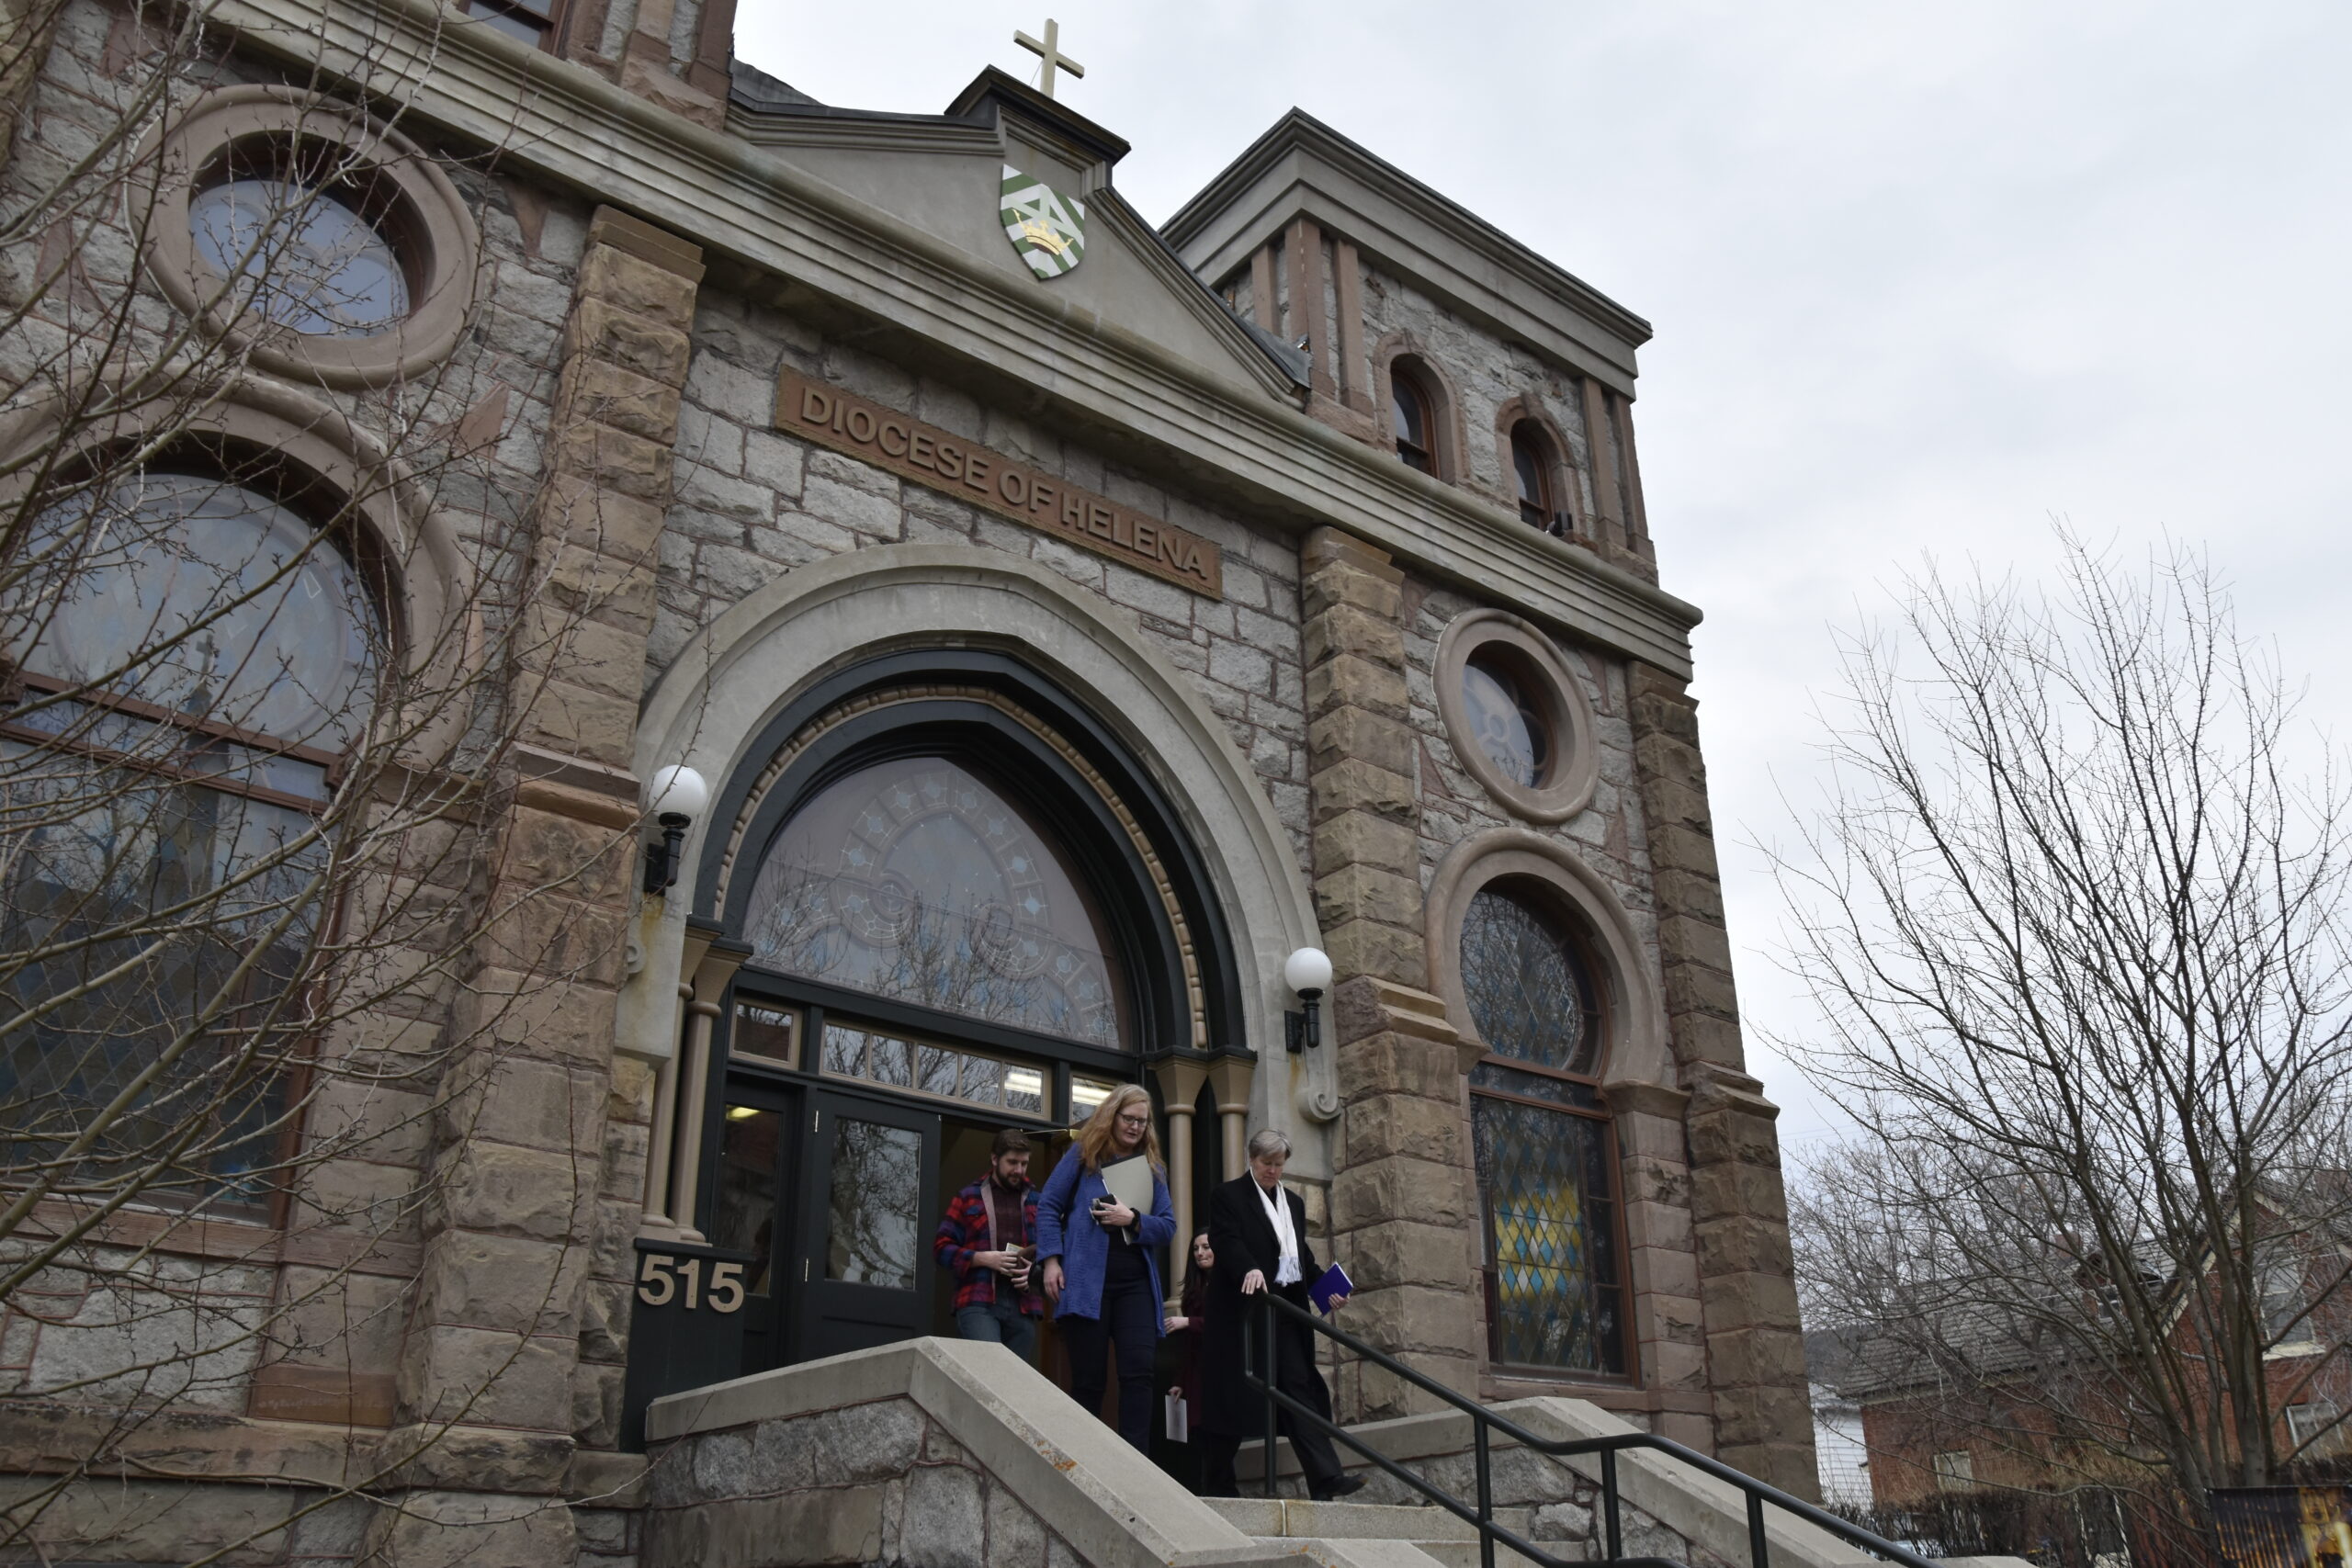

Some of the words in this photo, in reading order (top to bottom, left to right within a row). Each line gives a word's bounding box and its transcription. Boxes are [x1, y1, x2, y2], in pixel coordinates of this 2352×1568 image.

[801, 387, 989, 493] DIOCESE
[999, 468, 1053, 512] OF
[1061, 491, 1207, 580] HELENA
[638, 1254, 744, 1314] 515
